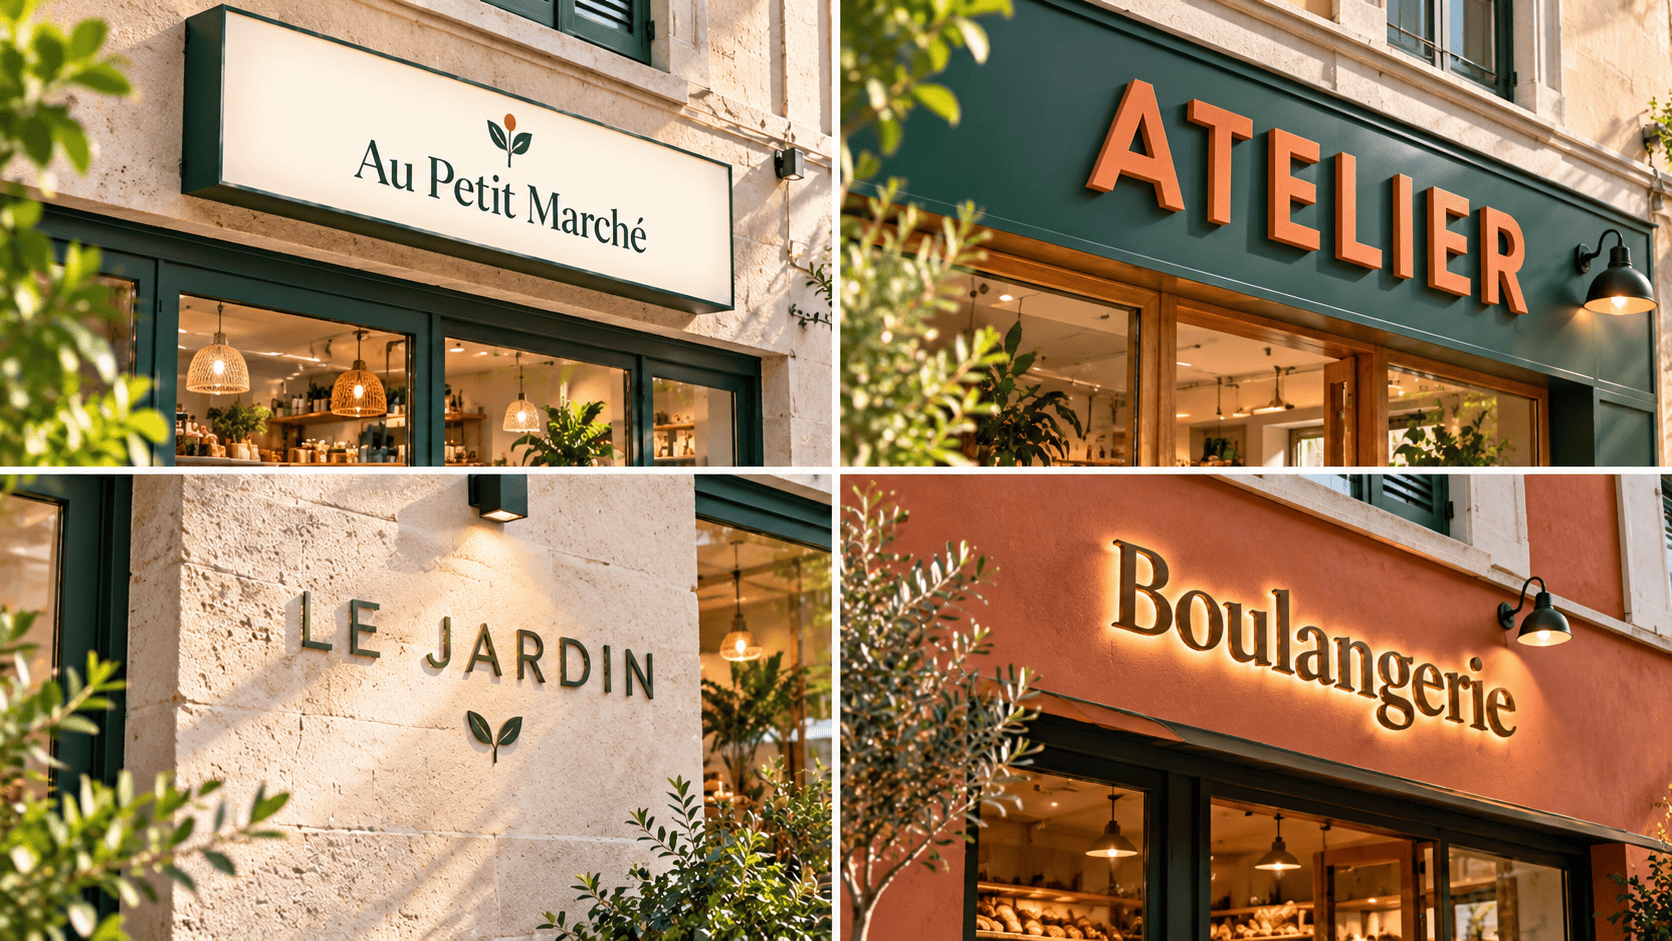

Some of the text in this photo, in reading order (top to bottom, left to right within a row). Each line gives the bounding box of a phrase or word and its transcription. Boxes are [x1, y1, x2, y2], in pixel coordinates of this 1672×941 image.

[354, 139, 647, 254] Au Petit Marché
[1085, 78, 1529, 315] ATELIER
[301, 591, 654, 700] LE JARDIN
[1111, 539, 1517, 738] Boulangerie
